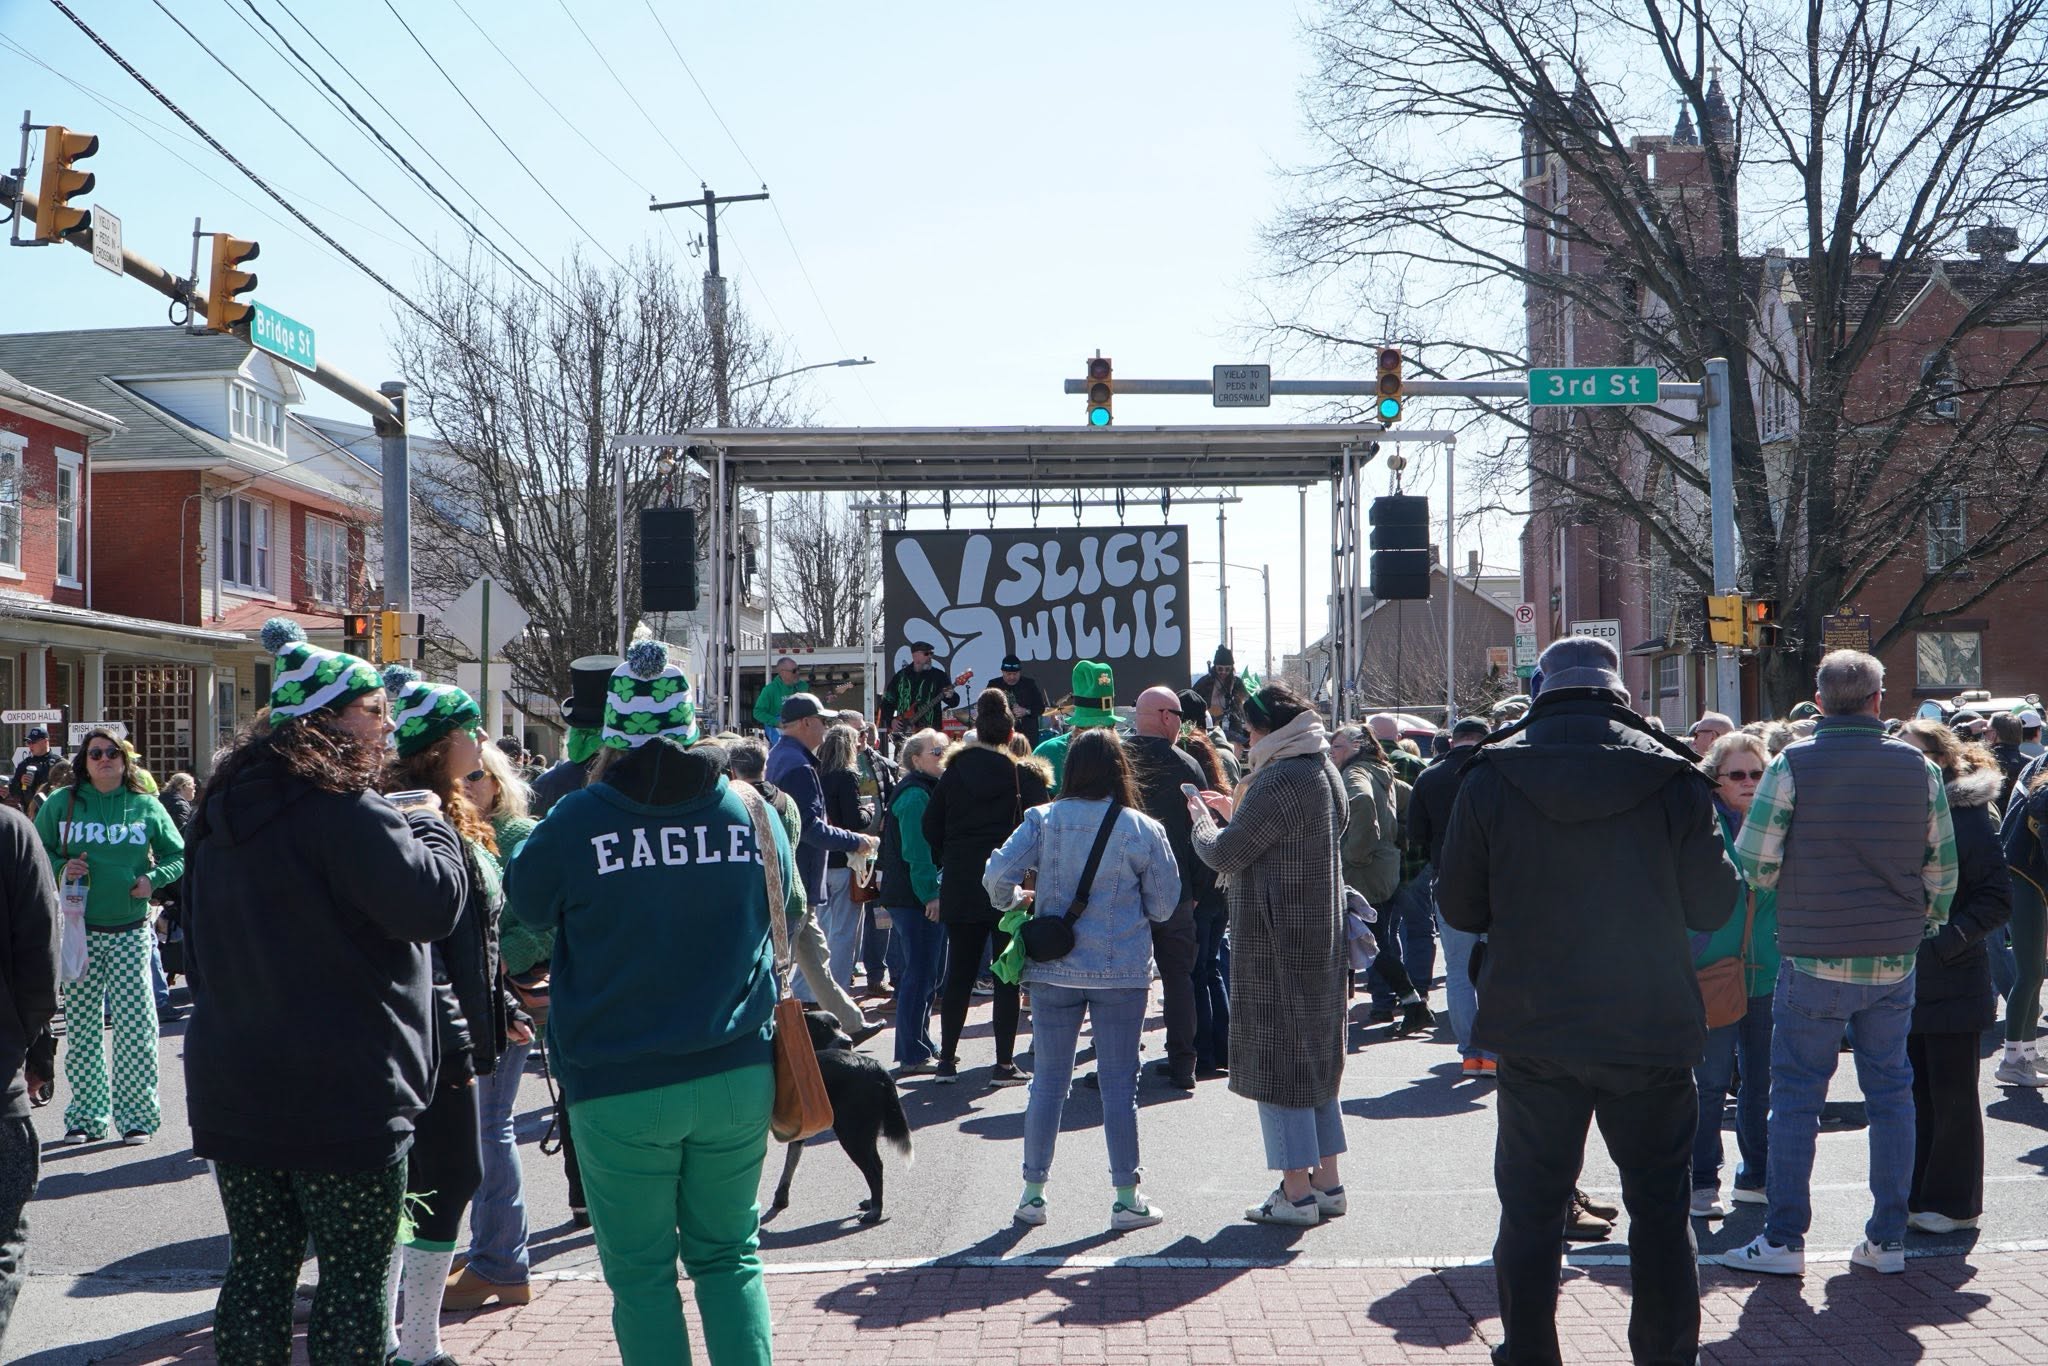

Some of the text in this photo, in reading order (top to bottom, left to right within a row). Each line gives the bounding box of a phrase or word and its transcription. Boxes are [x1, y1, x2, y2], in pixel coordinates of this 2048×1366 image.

[99, 215, 110, 230] YIELD
[99, 231, 110, 247] PEDS
[96, 246, 120, 267] CROSSWALK
[257, 309, 311, 358] Bridge St
[1223, 370, 1260, 379] YIELD TO
[1226, 382, 1258, 391] PEDS IN
[1549, 374, 1640, 396] 3rd St
[1218, 393, 1265, 402] CROSSWALK
[994, 531, 1180, 607] SLICK
[1010, 584, 1181, 661] WILLIE
[1576, 627, 1617, 638] SPEED
[7, 712, 58, 721] OXFORD HALL
[72, 724, 90, 733] IRISH
[58, 820, 147, 845] BIRDS
